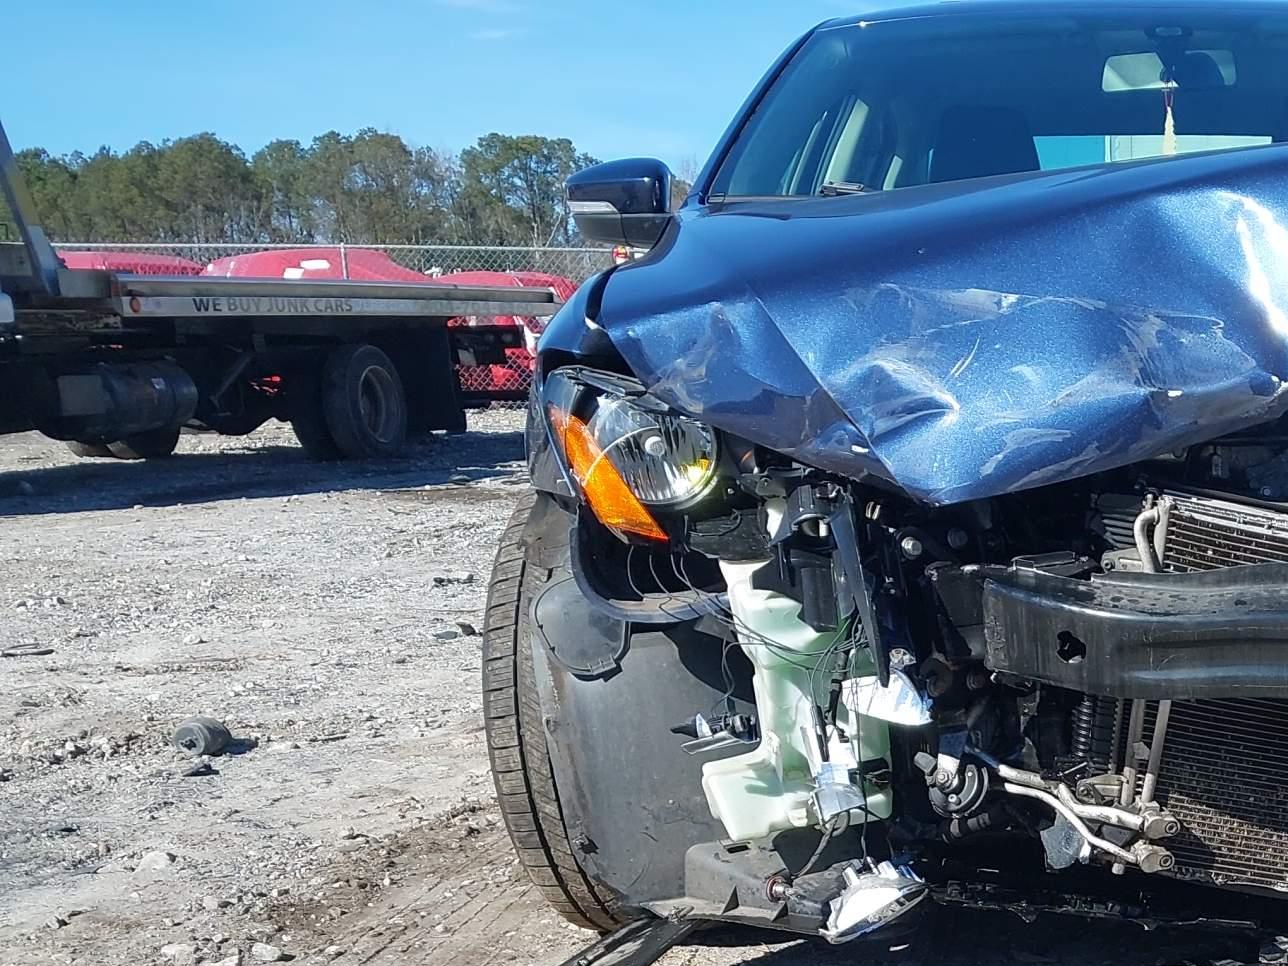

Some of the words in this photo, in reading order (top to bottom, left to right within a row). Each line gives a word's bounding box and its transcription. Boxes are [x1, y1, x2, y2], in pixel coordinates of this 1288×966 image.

[192, 297, 222, 312] WE
[227, 298, 262, 312] BUY
[266, 298, 311, 312] JUNK
[313, 299, 353, 313] CARS
